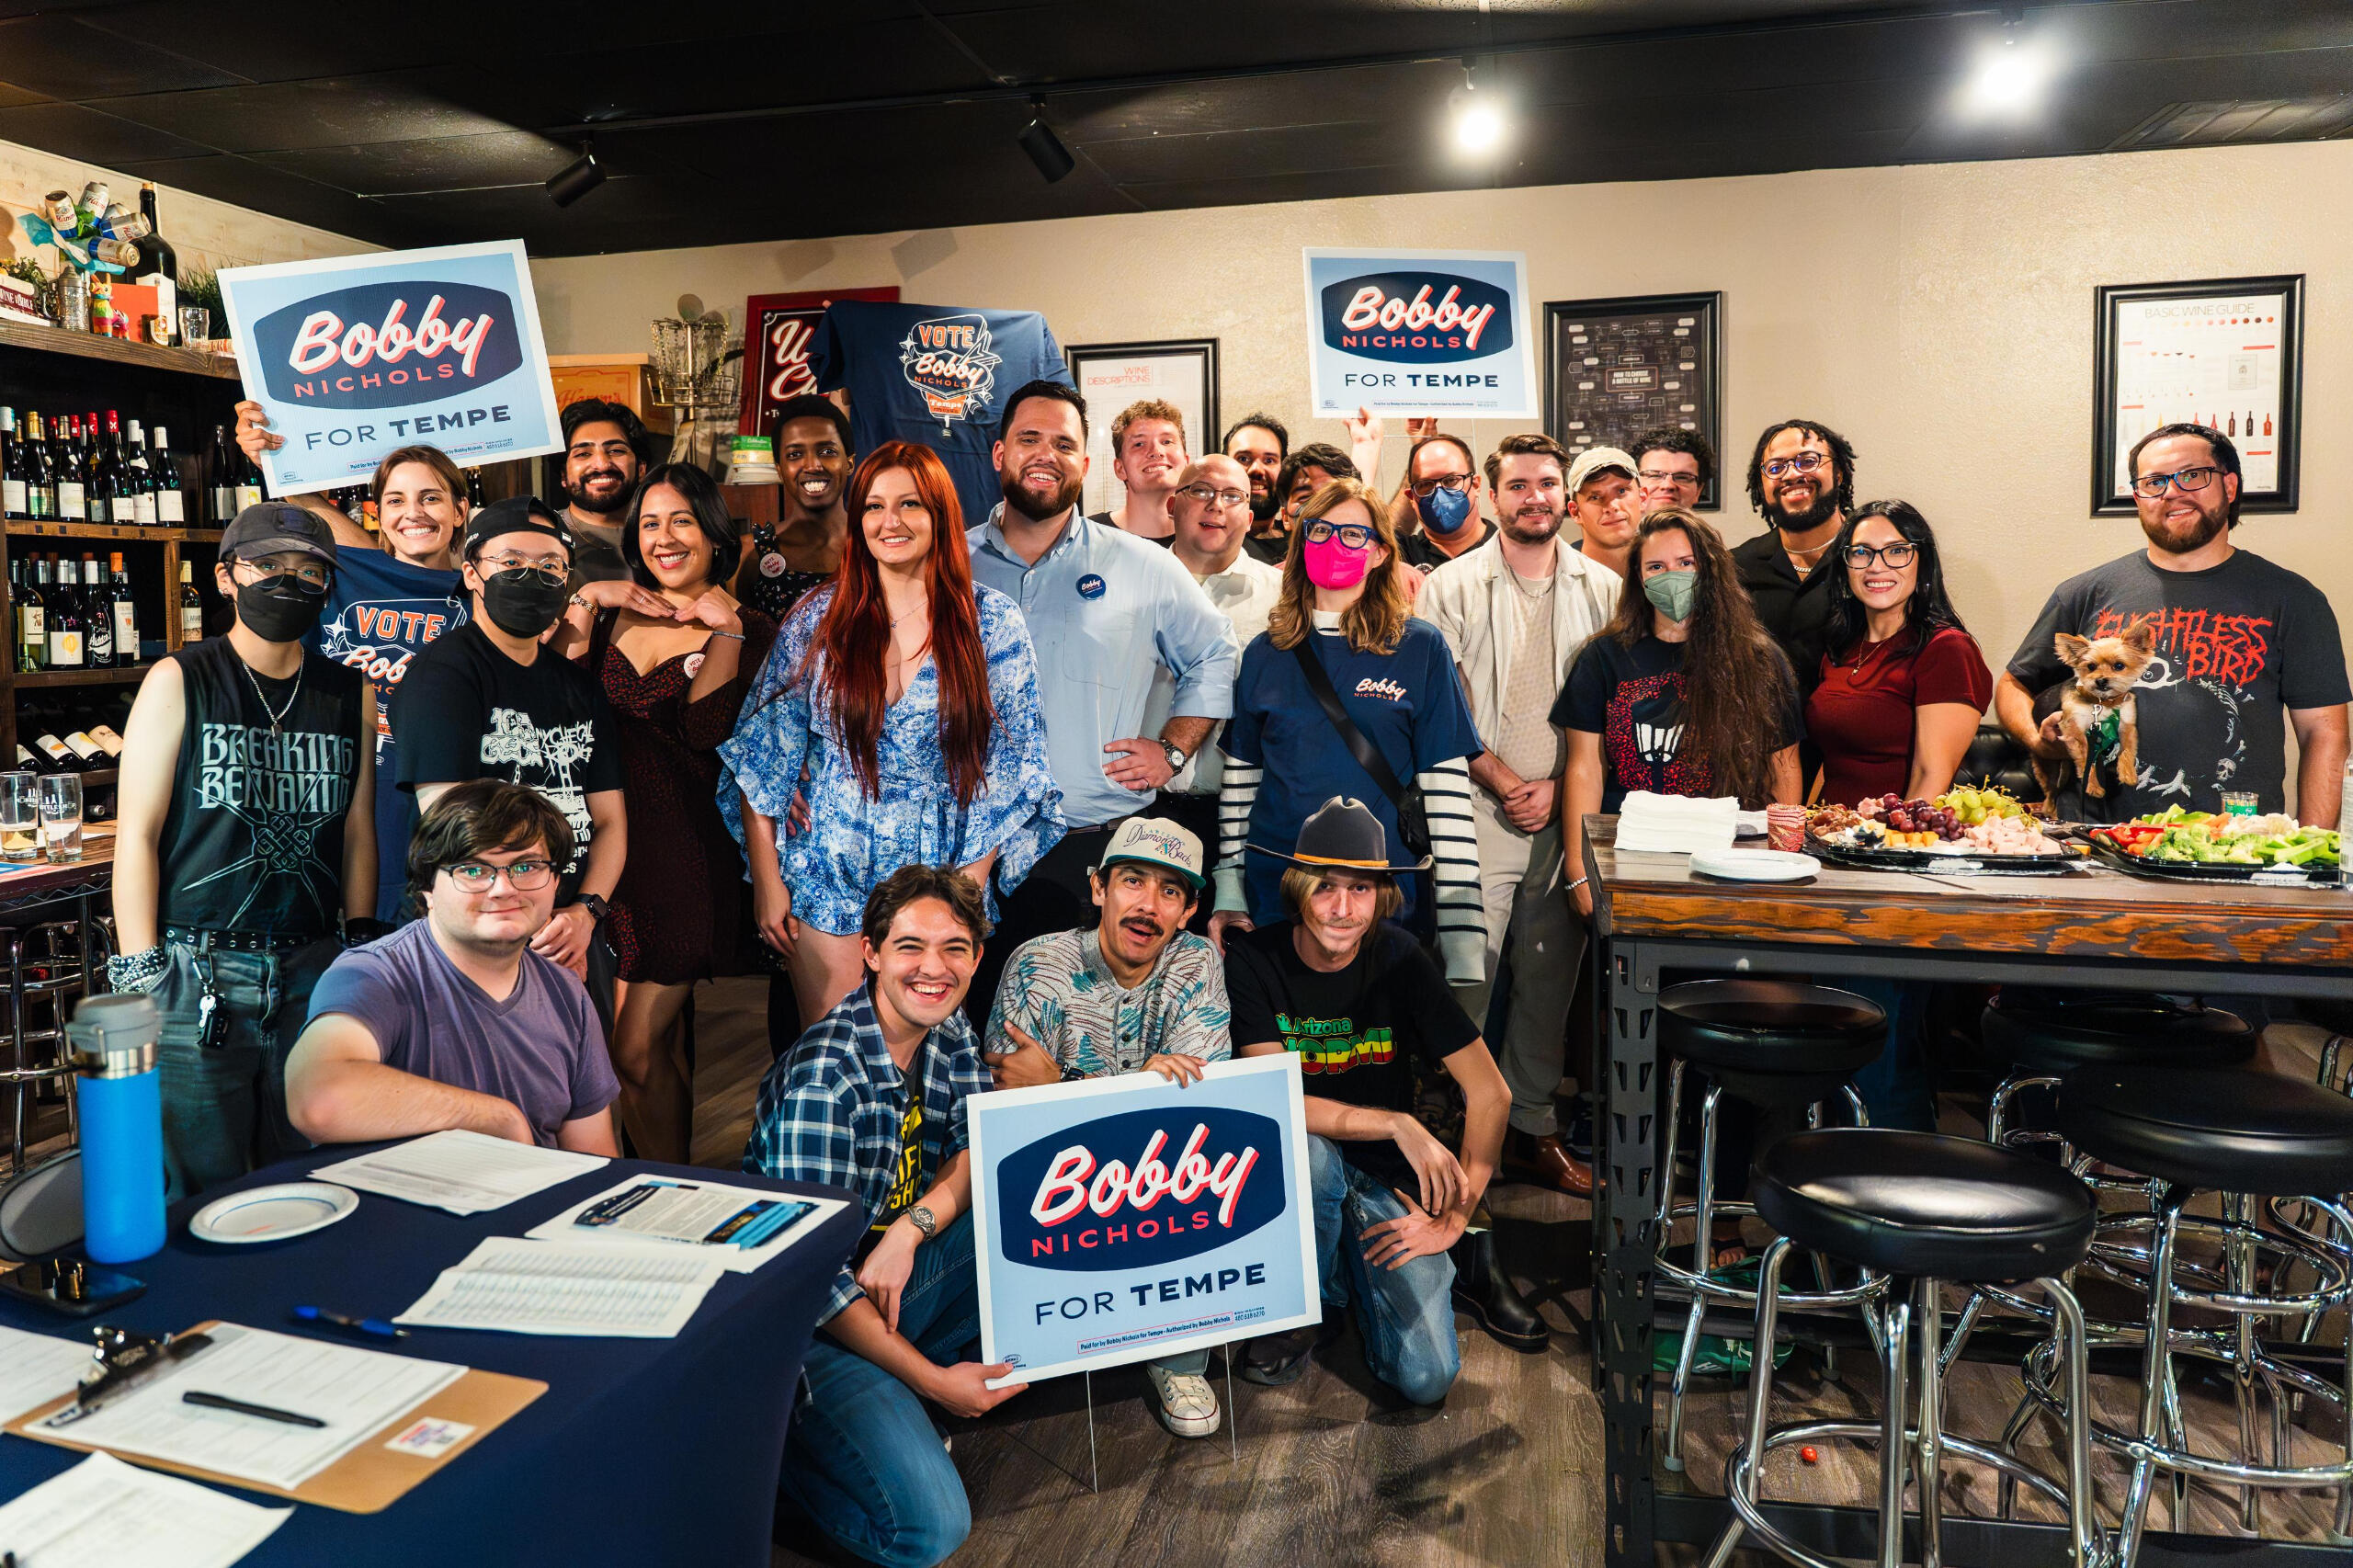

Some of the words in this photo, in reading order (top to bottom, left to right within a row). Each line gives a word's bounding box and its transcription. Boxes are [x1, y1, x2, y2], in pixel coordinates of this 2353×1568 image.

[1341, 284, 1495, 350] Bobby
[2144, 306, 2180, 319] BASIC
[2182, 304, 2214, 317] WINE
[2216, 302, 2255, 315] GUIDE
[289, 294, 494, 378] Bobby
[918, 324, 976, 349] VOTE
[1343, 335, 1461, 348] NICHOLS
[293, 363, 454, 398] NICHOLS
[914, 375, 969, 389] NICHOLS
[915, 352, 985, 391] Bobby
[1087, 375, 1150, 386] DESCRIPTIONS
[1123, 366, 1150, 375] WINE
[1345, 374, 1396, 387] FOR
[1406, 374, 1499, 388] TEMPE
[929, 399, 962, 409] Tempe
[305, 426, 378, 450] FOR
[389, 404, 512, 437] TEMPE
[356, 606, 447, 644] VOTE
[342, 645, 414, 684] Bob
[2186, 639, 2267, 689] BIRD
[1354, 692, 1393, 700] NICHOLS
[1355, 677, 1407, 702] Bobby
[199, 723, 354, 776] BREAKING
[199, 766, 349, 814] BENJAMIN
[1293, 1017, 1353, 1037] Arizona
[1030, 1122, 1259, 1229] Bobby
[1031, 1210, 1210, 1257] NICHOLS
[1035, 1291, 1115, 1325] FOR
[1130, 1263, 1267, 1307] TEMPE
[1107, 1337, 1121, 1346] Bobby
[1166, 1324, 1192, 1334] Authorized
[1199, 1320, 1213, 1328] Bobby
[1214, 1316, 1230, 1324] Nichols
